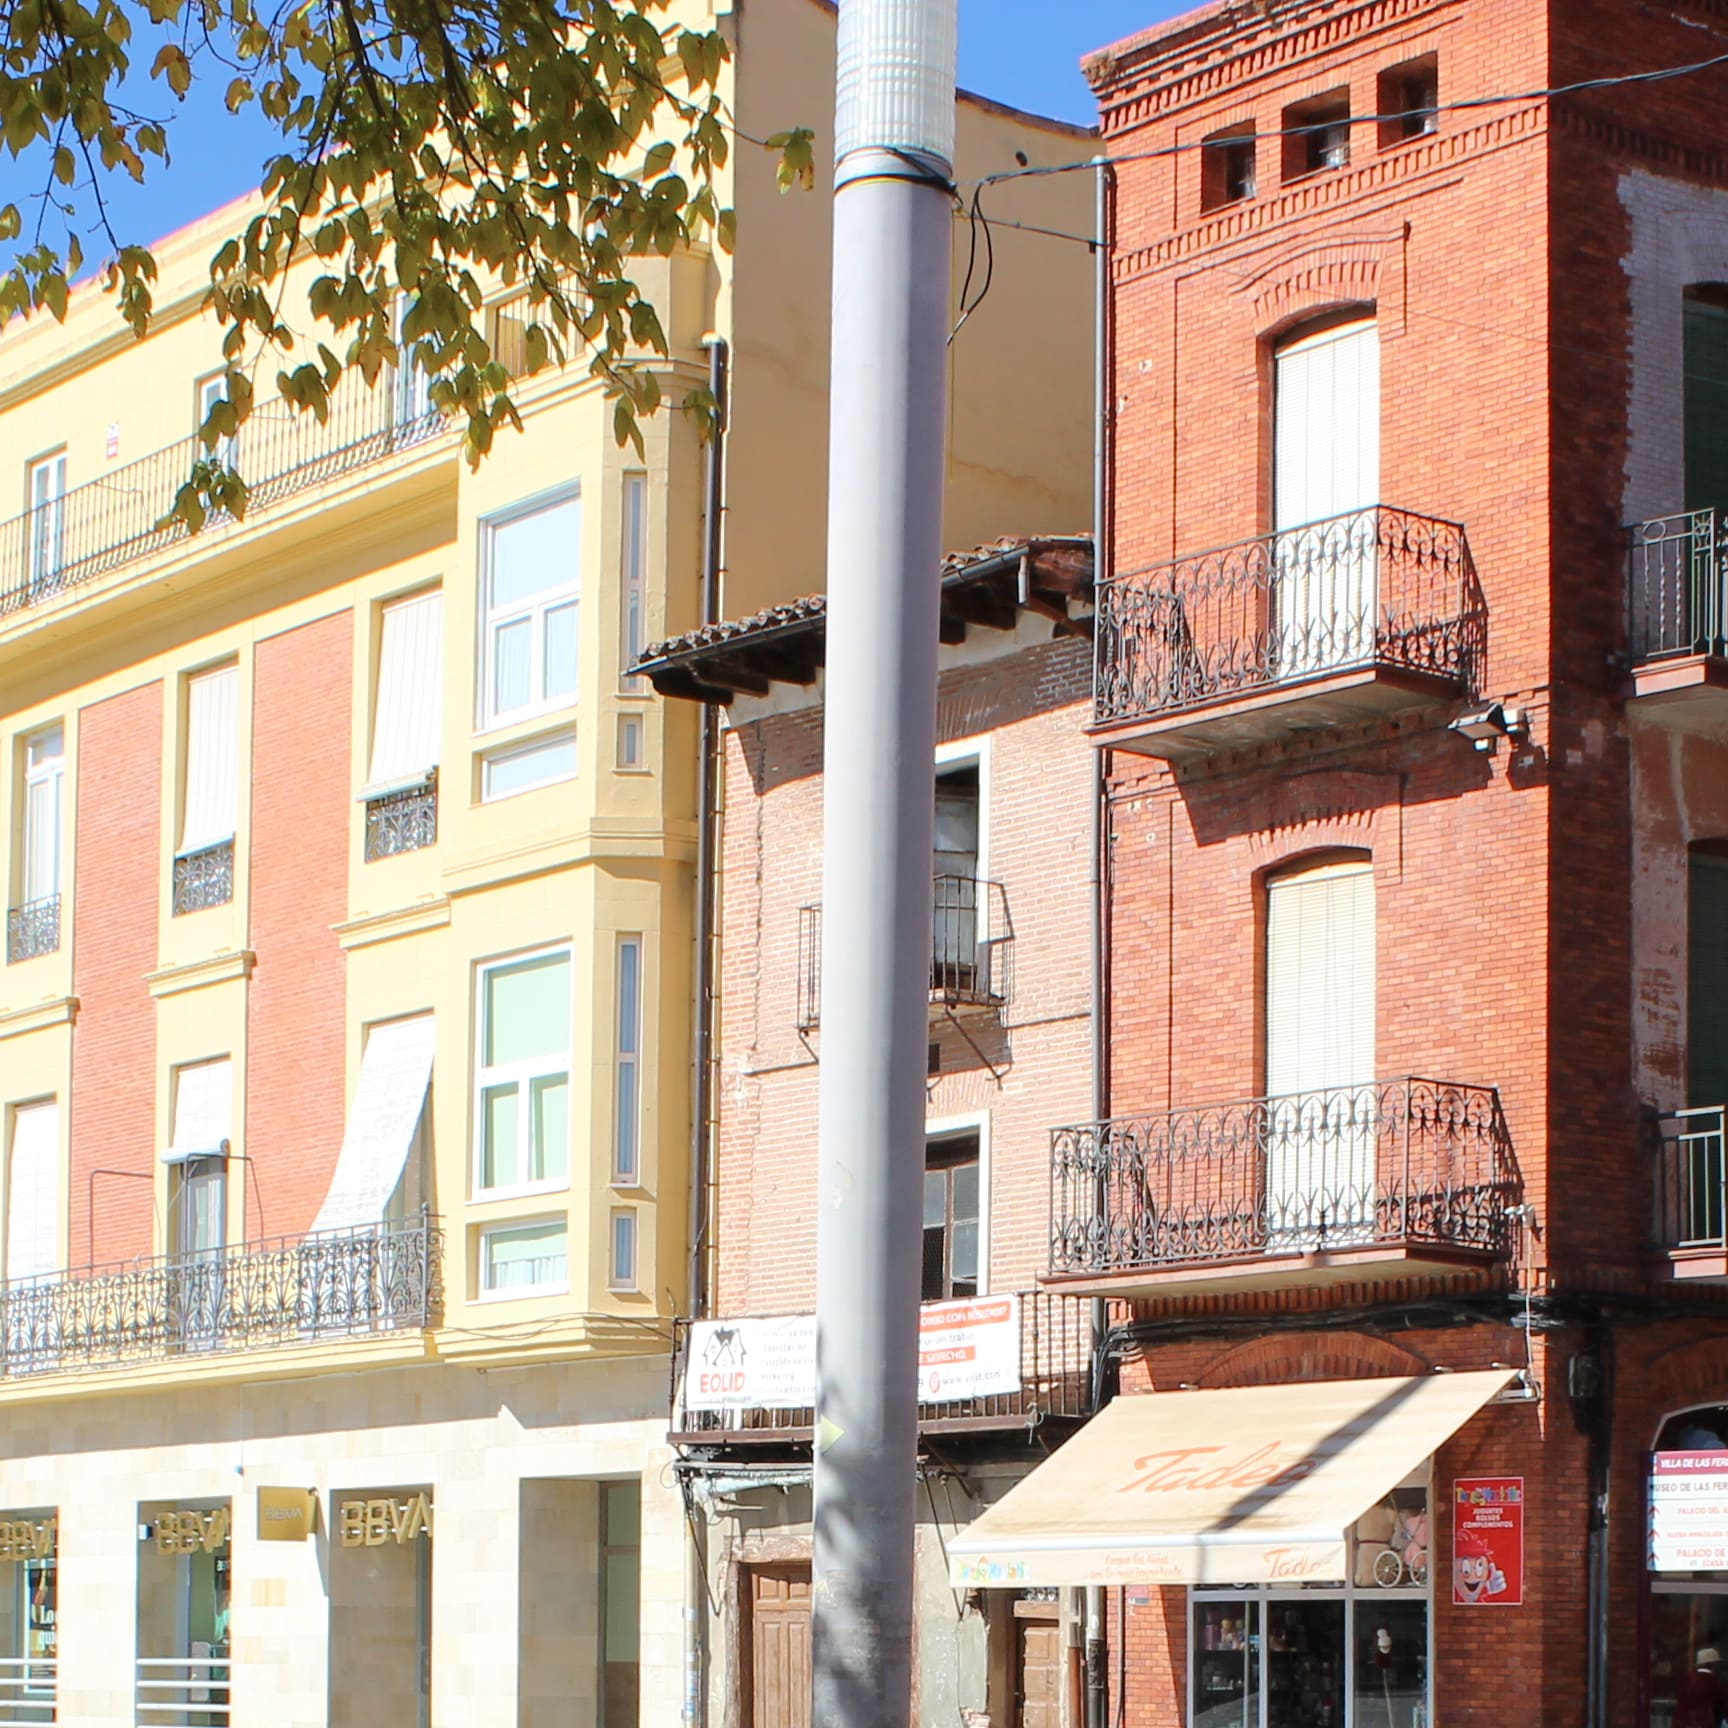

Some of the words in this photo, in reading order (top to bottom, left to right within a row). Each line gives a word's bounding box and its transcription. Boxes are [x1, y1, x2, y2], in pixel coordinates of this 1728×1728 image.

[700, 1372, 746, 1393] EOLID
[1115, 1440, 1317, 1493] Tadeo
[1660, 1459, 1681, 1468] VILLA
[1683, 1458, 1693, 1468] DE
[1694, 1458, 1710, 1467] LAS
[1680, 1482, 1691, 1492] DE
[1694, 1482, 1709, 1491] LAS
[265, 1506, 304, 1521] BBVA
[341, 1492, 434, 1548] BBVA
[157, 1507, 230, 1556] BBVA
[1676, 1549, 1711, 1558] PALACIO
[1714, 1549, 1726, 1557] DE
